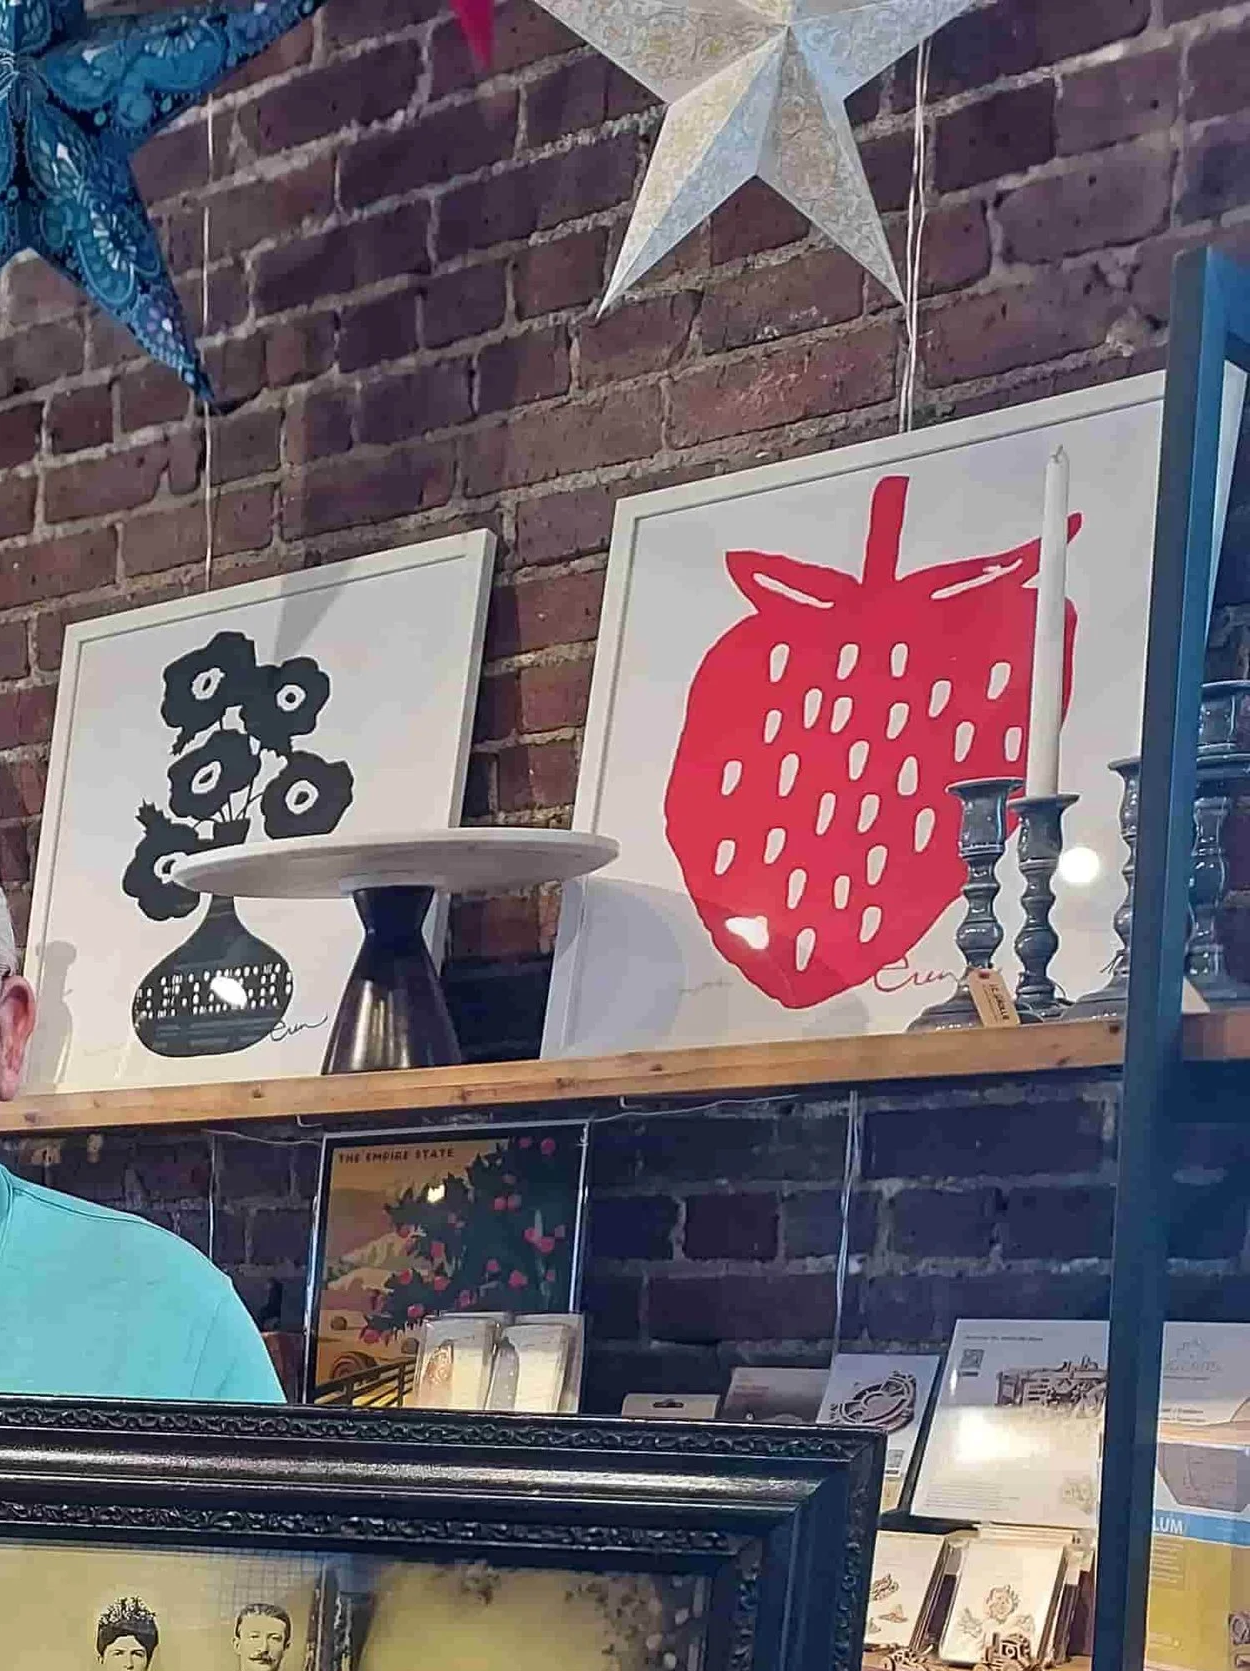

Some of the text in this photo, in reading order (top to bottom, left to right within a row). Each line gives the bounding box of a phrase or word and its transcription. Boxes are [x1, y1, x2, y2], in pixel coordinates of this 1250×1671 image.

[338, 1147, 455, 1164] THE EMPIRE STATE
